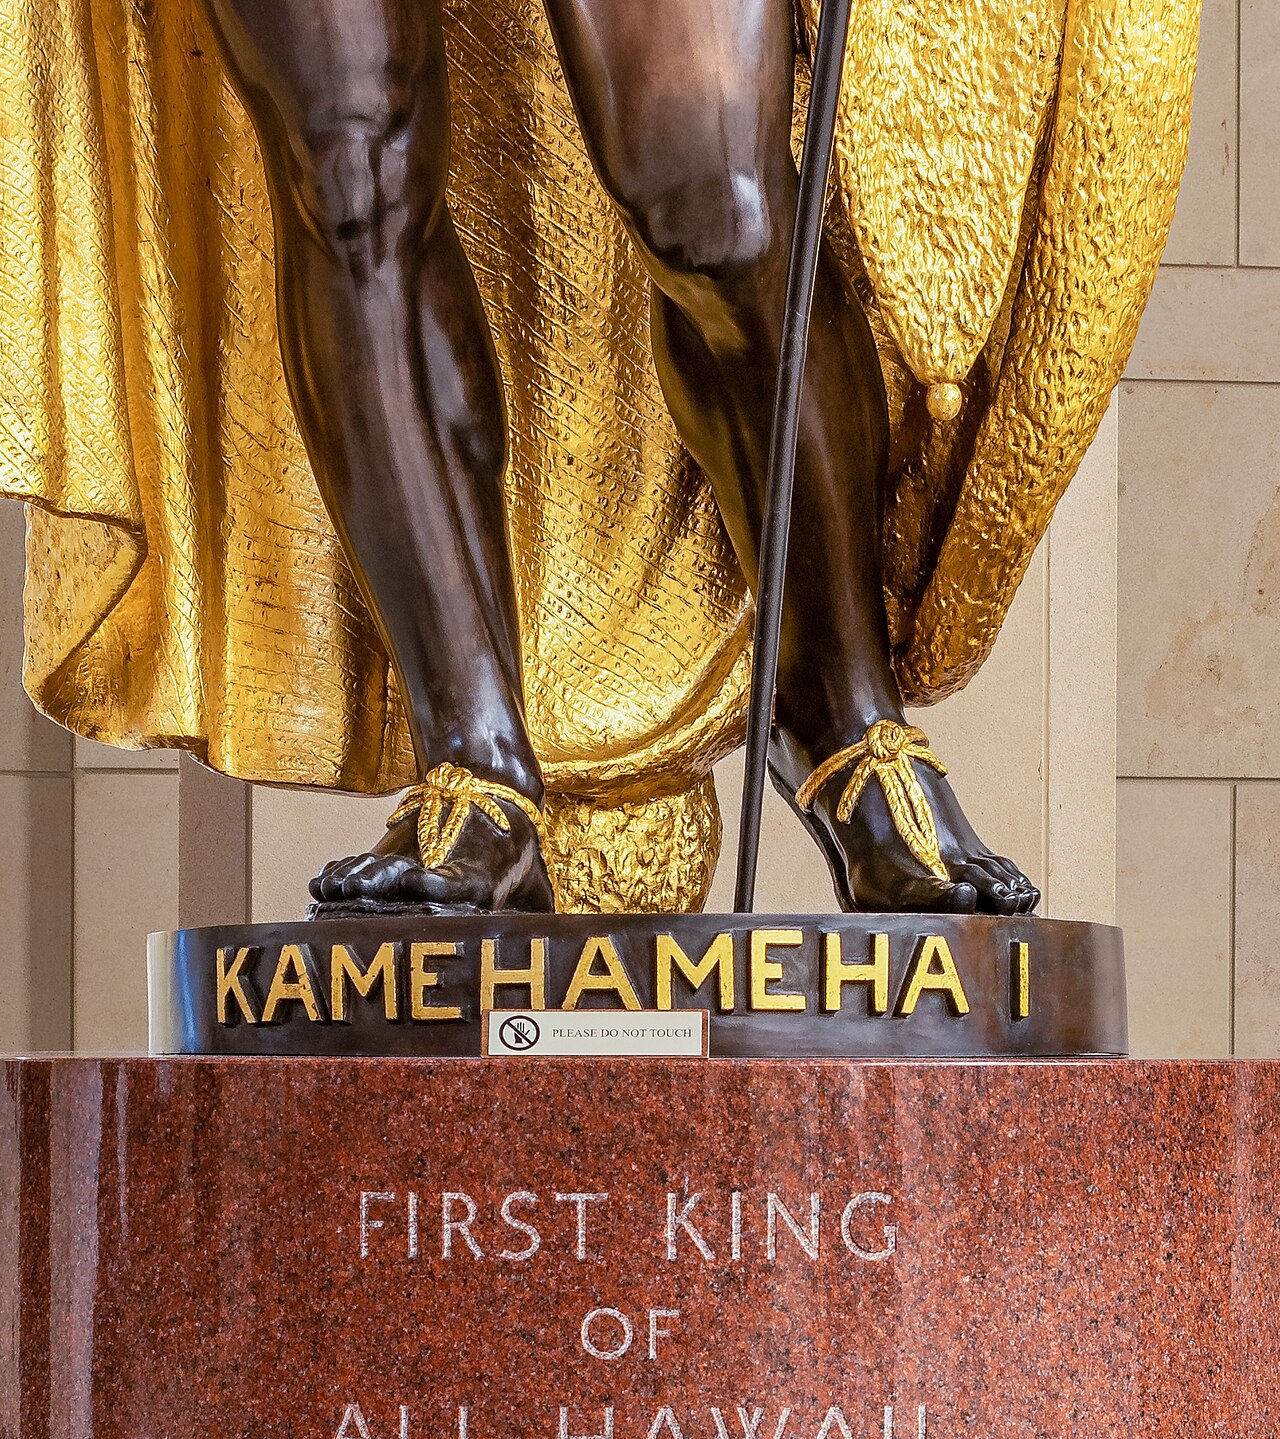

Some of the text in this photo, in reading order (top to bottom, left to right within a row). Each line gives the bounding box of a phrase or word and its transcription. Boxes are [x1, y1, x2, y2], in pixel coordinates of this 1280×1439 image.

[216, 929, 1030, 1024] KAMEHAMEHA I
[552, 1028, 692, 1038] PLEASE DO NOT TOUCH
[359, 1190, 899, 1261] FIRST KING
[581, 1307, 680, 1361] OF
